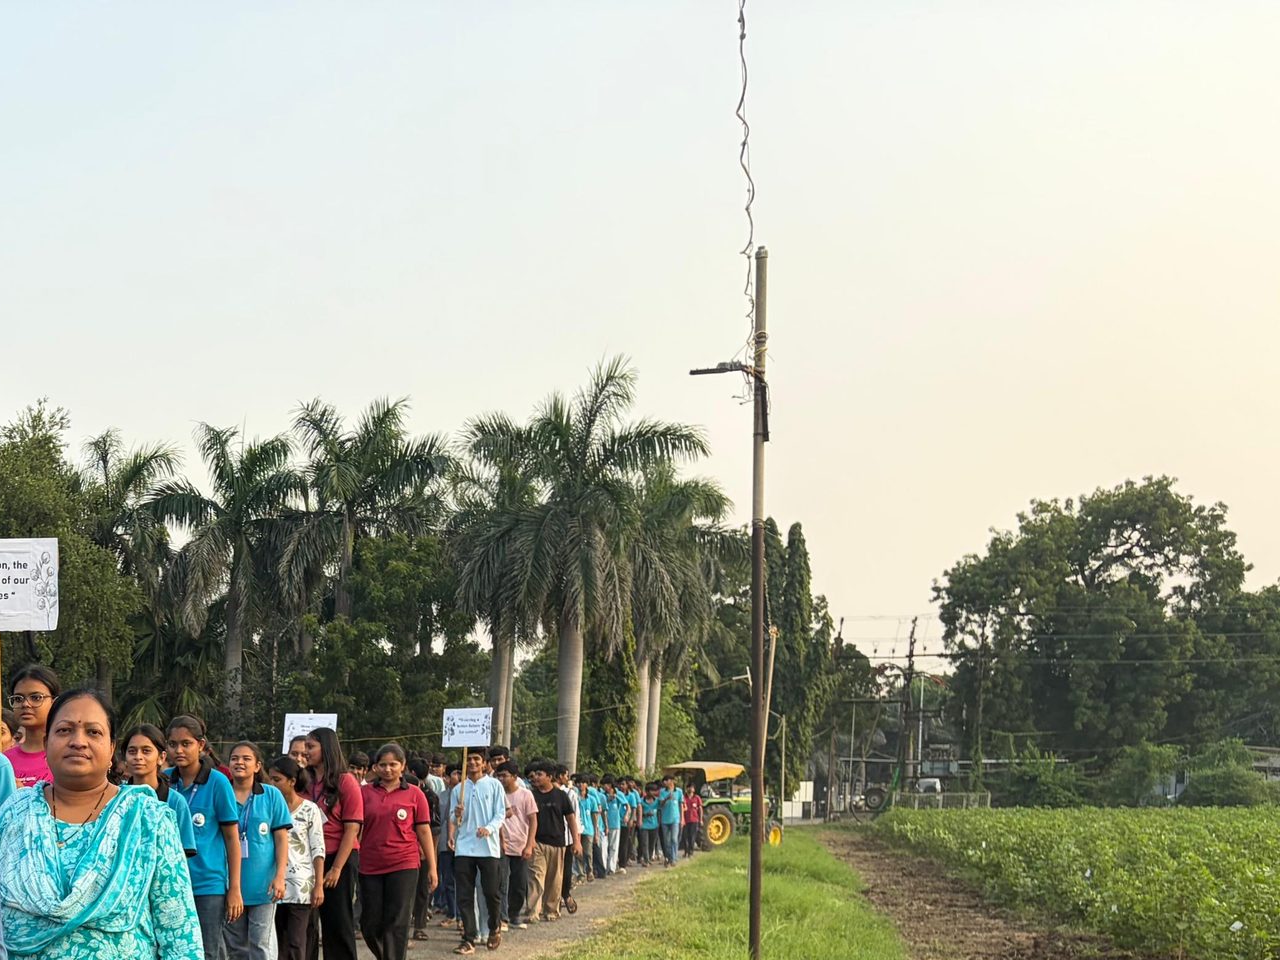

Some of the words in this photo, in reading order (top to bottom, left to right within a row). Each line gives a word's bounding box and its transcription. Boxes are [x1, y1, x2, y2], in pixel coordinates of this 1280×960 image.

[13, 560, 28, 570] the
[1, 575, 11, 585] of
[13, 577, 30, 585] our
